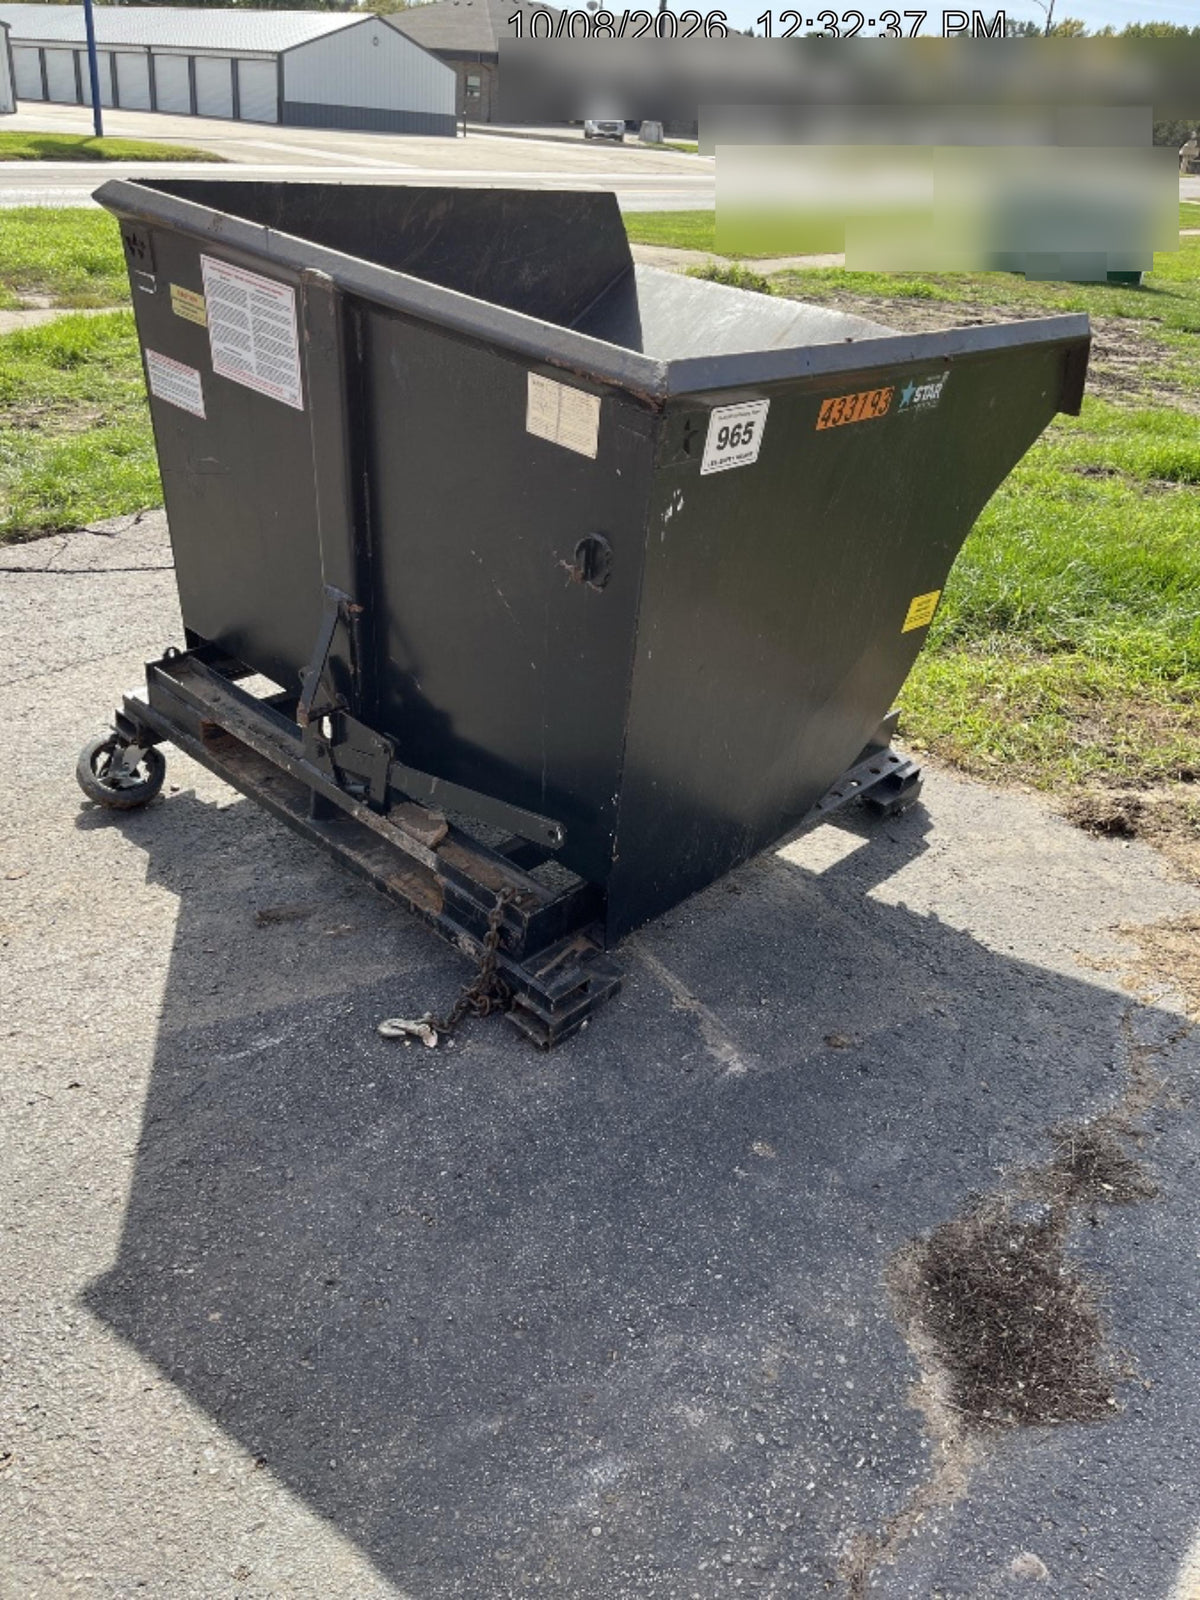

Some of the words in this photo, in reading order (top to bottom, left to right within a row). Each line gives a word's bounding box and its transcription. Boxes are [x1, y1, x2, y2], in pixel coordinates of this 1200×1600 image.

[821, 388, 893, 427] 433193
[912, 383, 943, 403] STAR
[716, 421, 756, 451] 965
